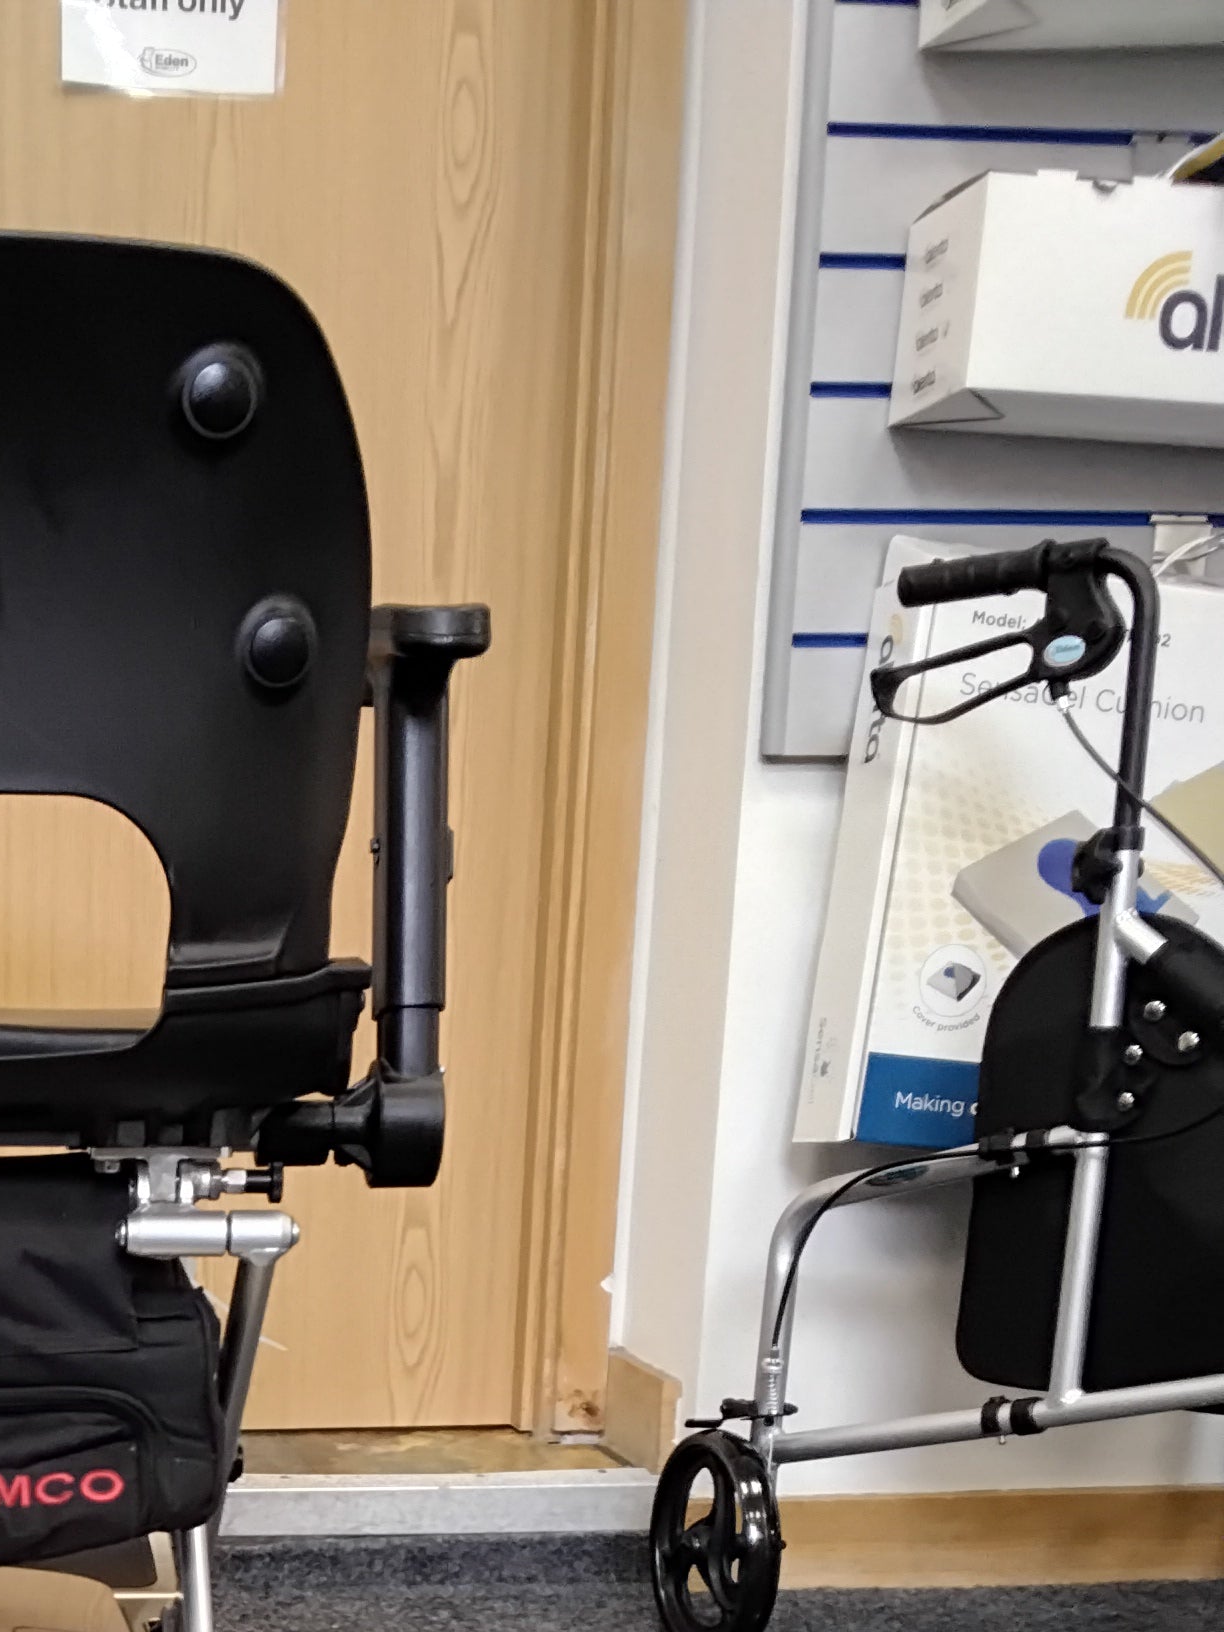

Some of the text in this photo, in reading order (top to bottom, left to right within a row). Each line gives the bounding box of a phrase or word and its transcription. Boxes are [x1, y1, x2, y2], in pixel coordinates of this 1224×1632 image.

[155, 53, 189, 67] Eden
[912, 1005, 937, 1027] Cover
[894, 1090, 965, 1118] Making
